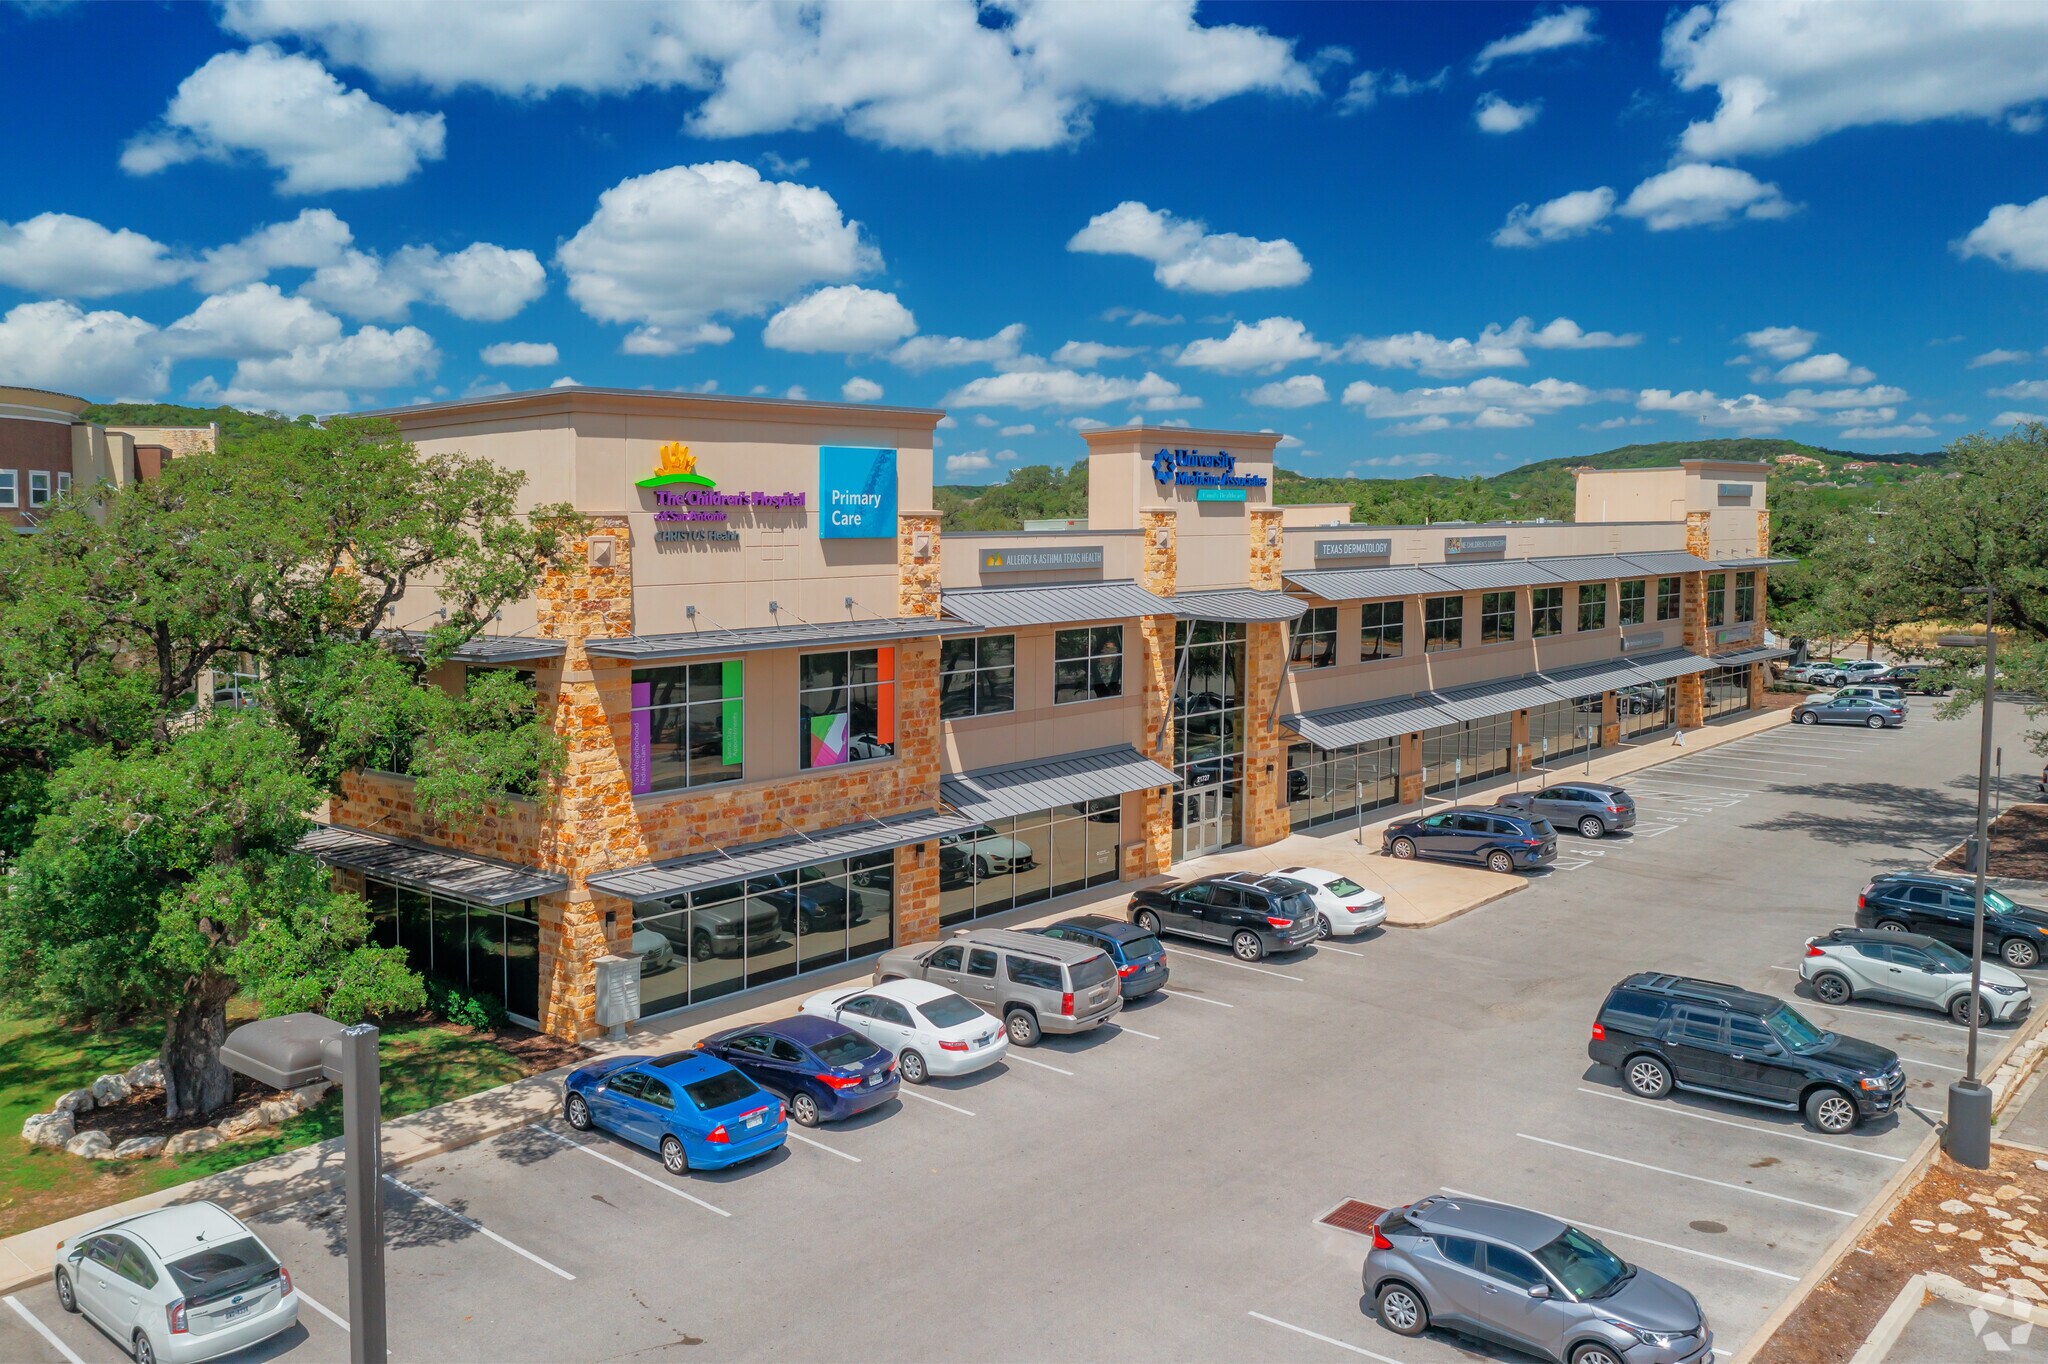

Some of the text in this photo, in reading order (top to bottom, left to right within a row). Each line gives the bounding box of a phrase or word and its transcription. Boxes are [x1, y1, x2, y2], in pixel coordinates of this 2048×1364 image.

[1175, 449, 1236, 473] University
[1175, 471, 1267, 487] Medicine Associates
[655, 490, 806, 509] The Children's Hospital
[832, 490, 881, 508] Primary
[654, 511, 728, 522] of San Antonio
[832, 510, 862, 526] Care
[654, 529, 740, 543] CHRISTUS Health
[1323, 542, 1388, 555] TEXAS DERMATOLOGY
[1006, 552, 1102, 566] ALLERGY & ASTHMA TEXAS HEALTH
